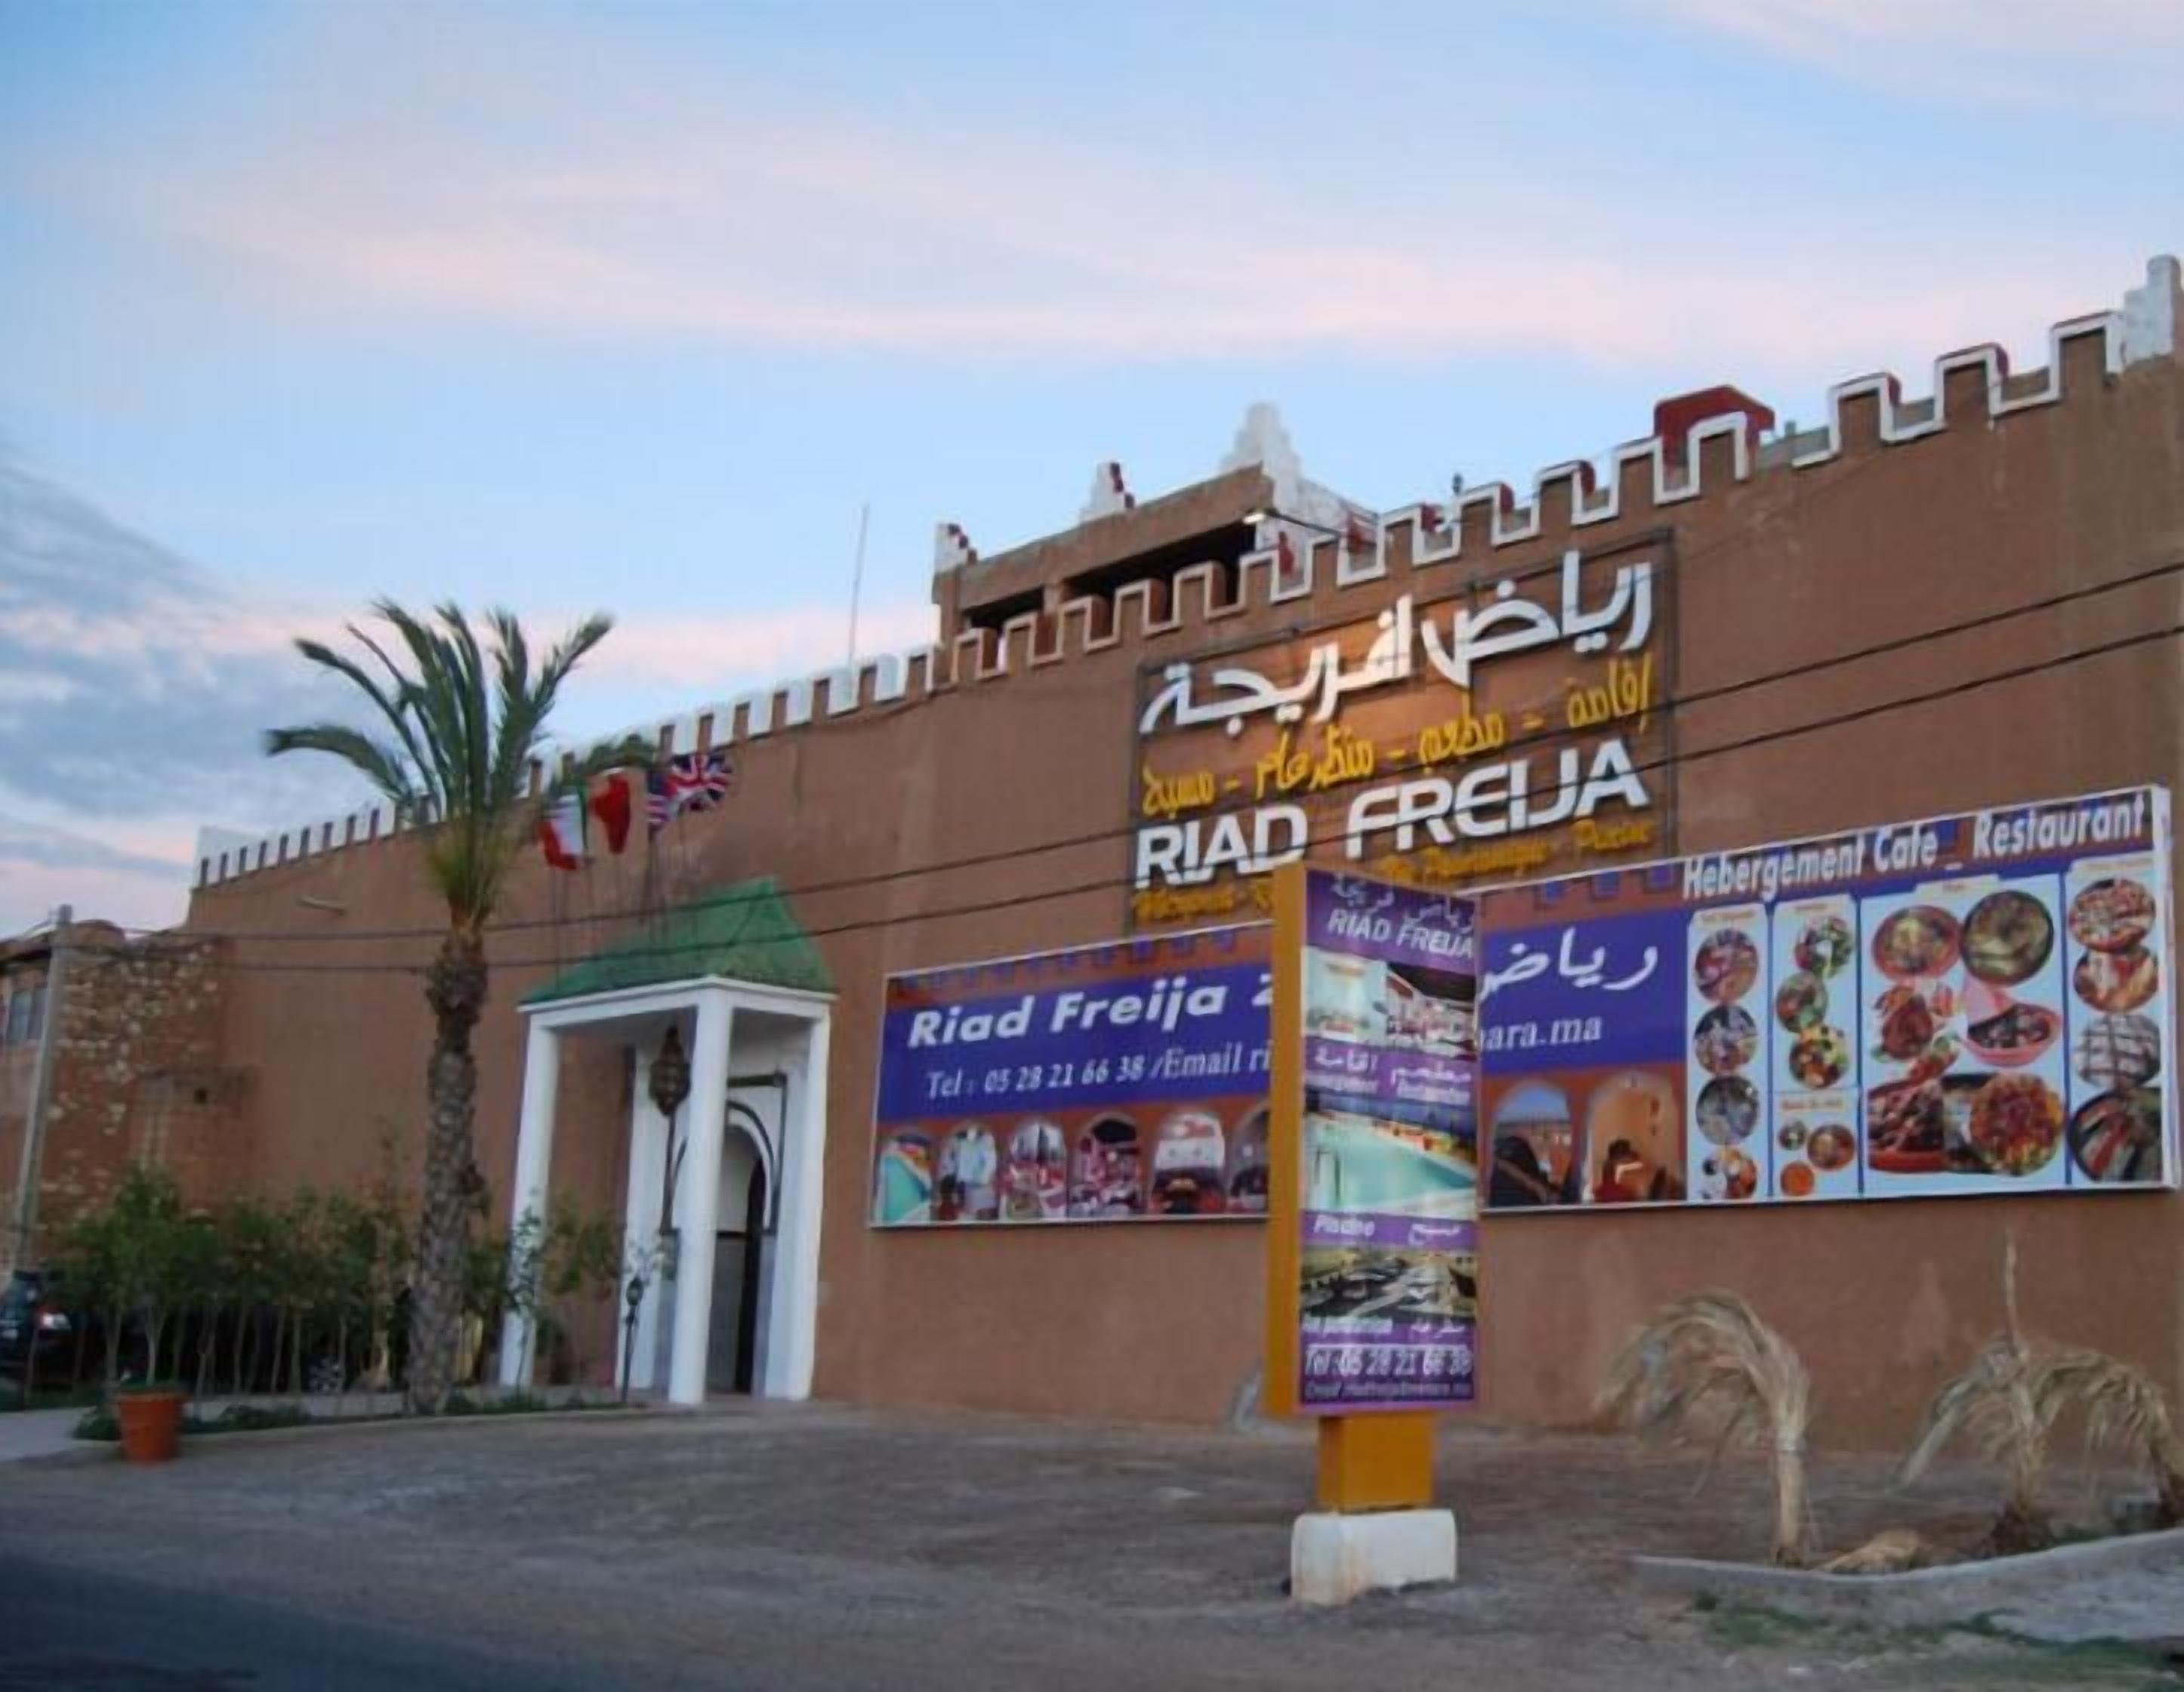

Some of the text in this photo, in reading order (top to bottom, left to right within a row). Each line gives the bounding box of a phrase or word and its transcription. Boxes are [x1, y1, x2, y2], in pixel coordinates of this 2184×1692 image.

[1421, 550, 1652, 687] رياض
[1136, 737, 1650, 889] RIAD FREIJA
[1683, 833, 1866, 903] Hebergement
[1973, 791, 2145, 859] Restaurant
[1326, 908, 1392, 943] RIAD
[908, 995, 1035, 1048] Riad
[1050, 976, 1228, 1032] Freija
